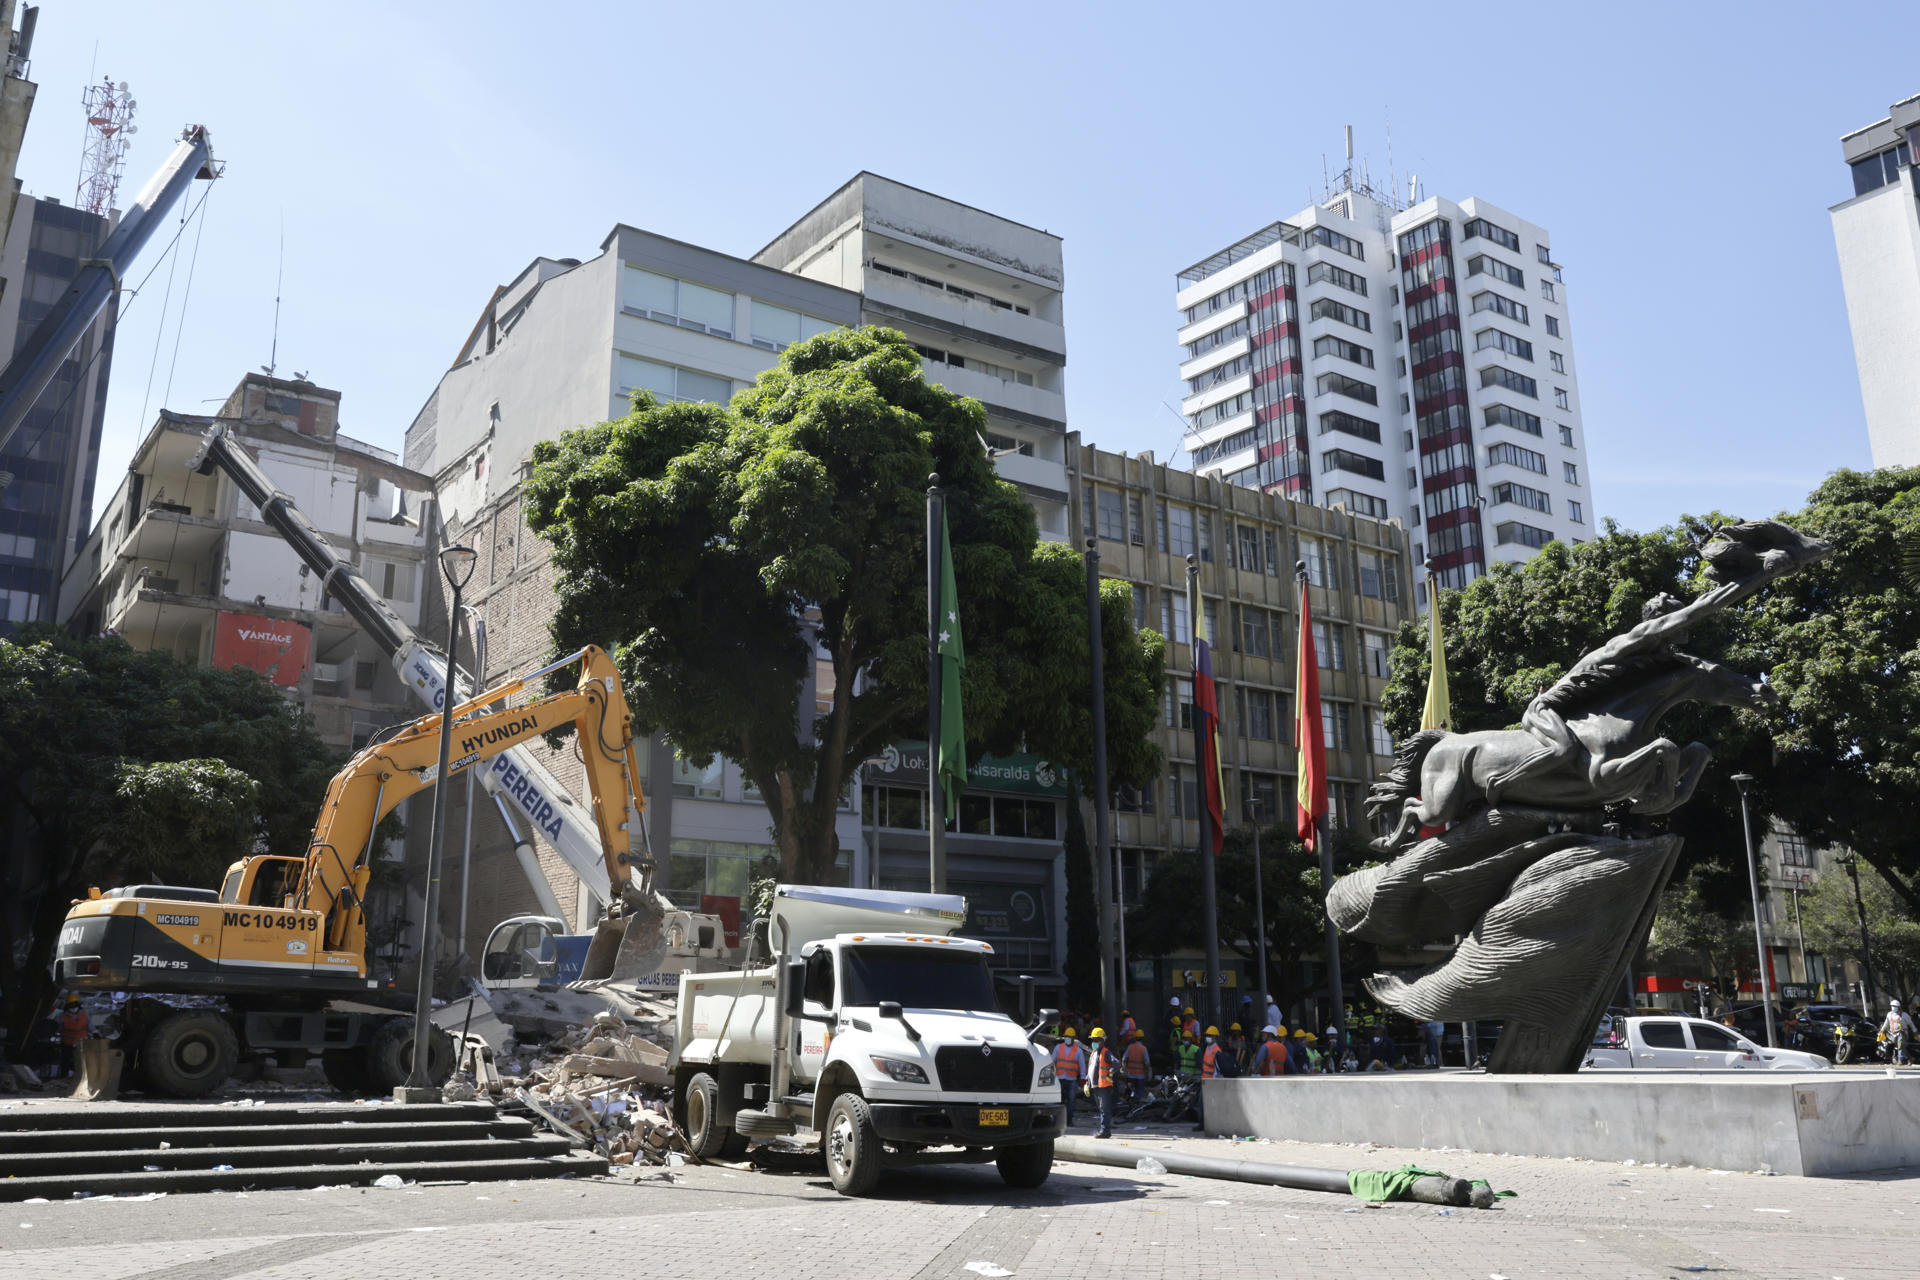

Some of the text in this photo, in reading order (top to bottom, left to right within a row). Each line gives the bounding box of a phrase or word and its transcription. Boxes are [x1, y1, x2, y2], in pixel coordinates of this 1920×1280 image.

[237, 628, 292, 643] VANTAGE
[461, 715, 538, 753] HYUNDAI
[449, 752, 480, 771] MC104919
[492, 753, 563, 842] PEREIRA
[157, 915, 199, 925] MC104919
[223, 912, 318, 932] MC104919
